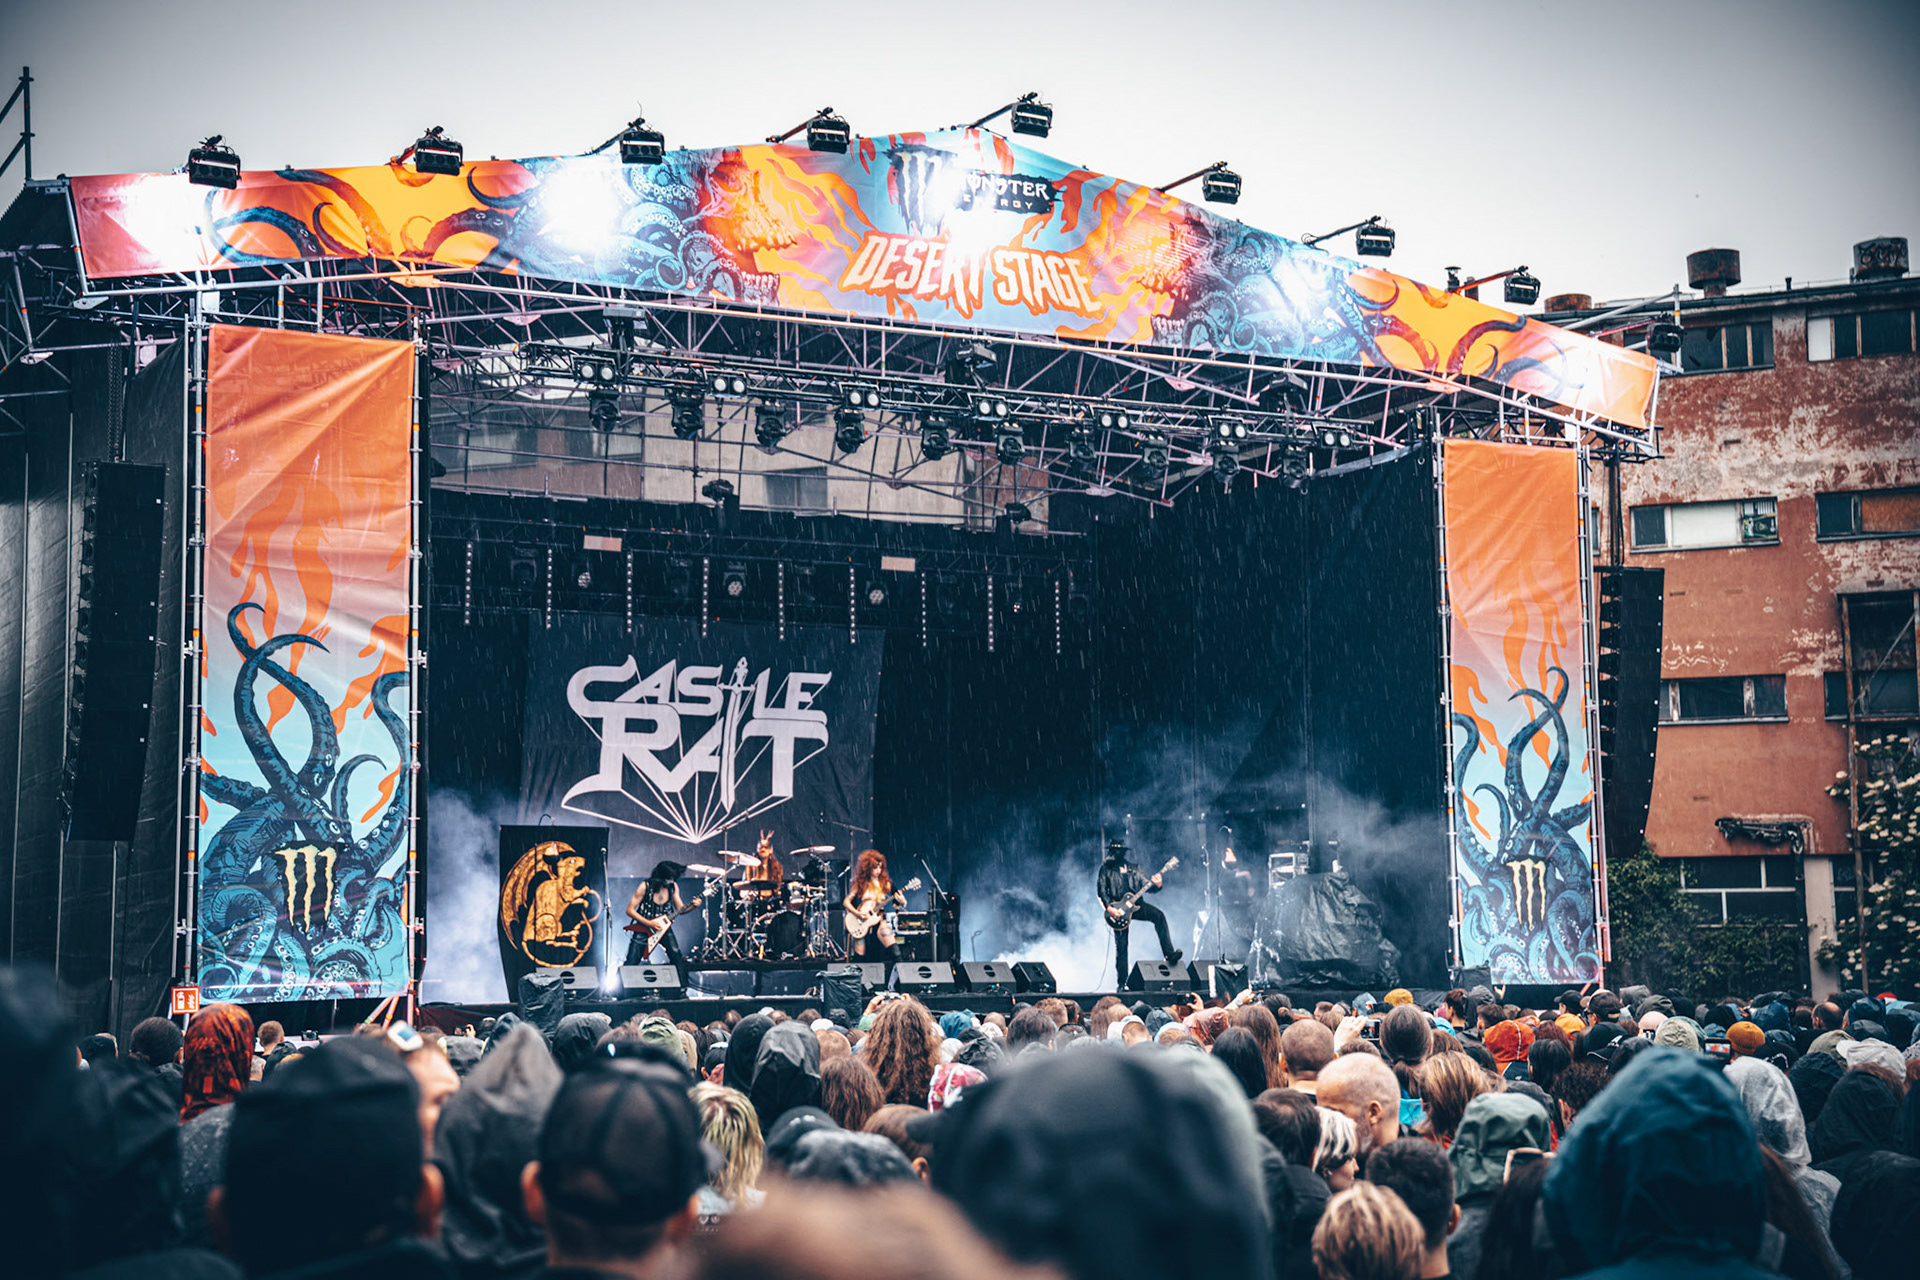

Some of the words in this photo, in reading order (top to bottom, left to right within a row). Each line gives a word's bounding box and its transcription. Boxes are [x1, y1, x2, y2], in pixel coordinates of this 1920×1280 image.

[959, 171, 1050, 200] ONSTER
[842, 235, 983, 314] DESERT
[993, 249, 1102, 313] STAGE
[566, 654, 832, 726] CASTLE
[561, 703, 829, 808] RAT
